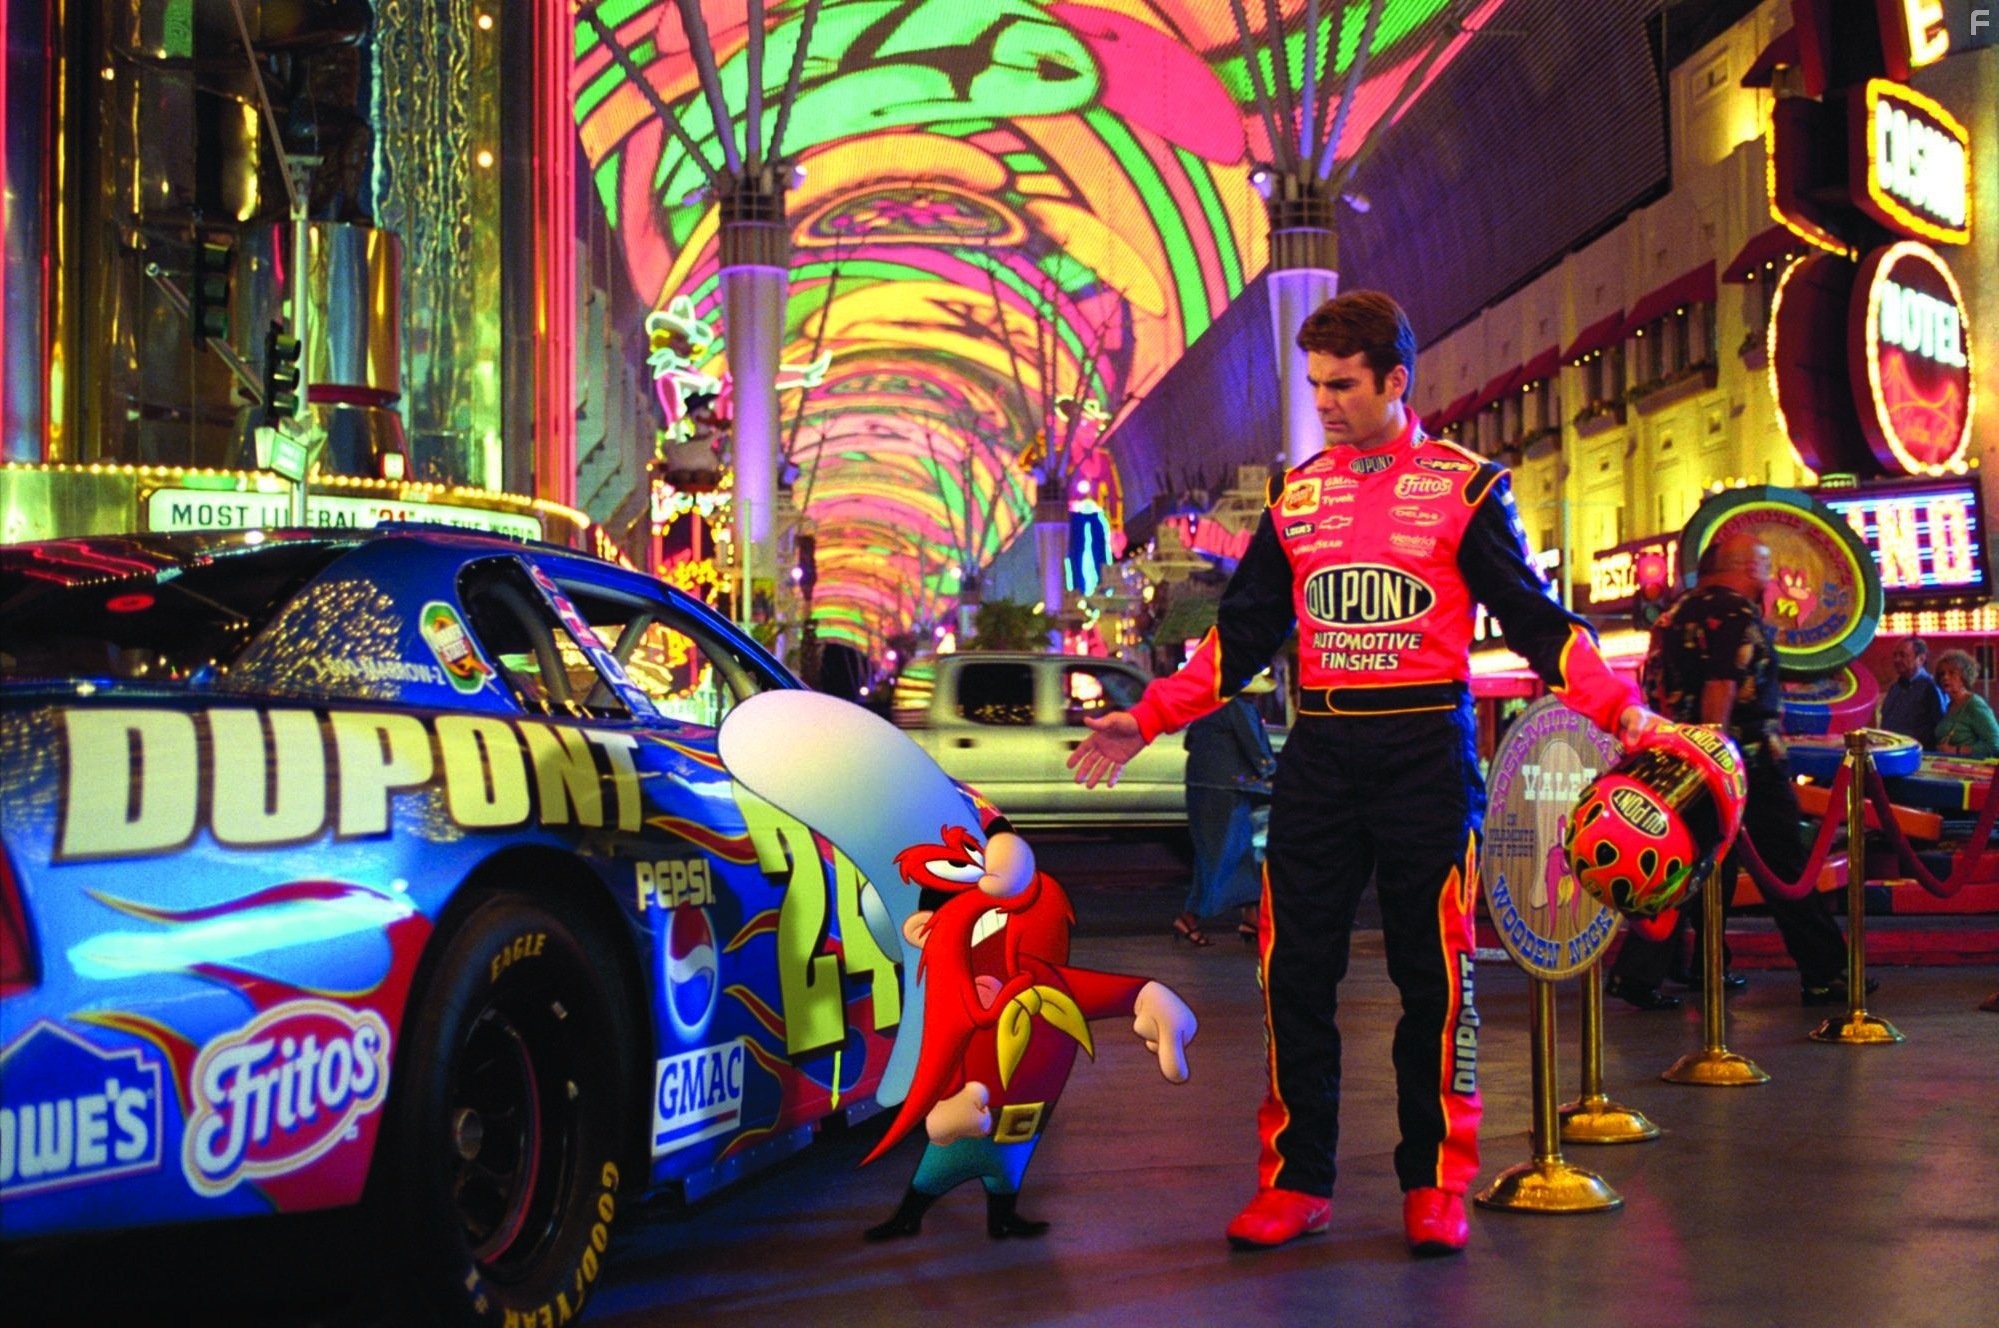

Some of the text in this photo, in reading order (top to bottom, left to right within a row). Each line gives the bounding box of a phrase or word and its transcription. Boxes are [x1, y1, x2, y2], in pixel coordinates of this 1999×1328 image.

[1400, 476, 1449, 497] Fritos
[172, 503, 249, 527] MOST
[261, 509, 356, 529] LIERAL
[1313, 631, 1422, 651] AUTOMOTIVE
[1321, 652, 1399, 671] FINSHES
[60, 707, 642, 860] DUPONT
[1521, 764, 1598, 801] VALET
[635, 859, 713, 912] PEPSI
[1492, 873, 1561, 969] WOODEN
[491, 933, 547, 984] EAGLE
[195, 1024, 381, 1174] Fritos
[658, 1045, 742, 1120] GMAC
